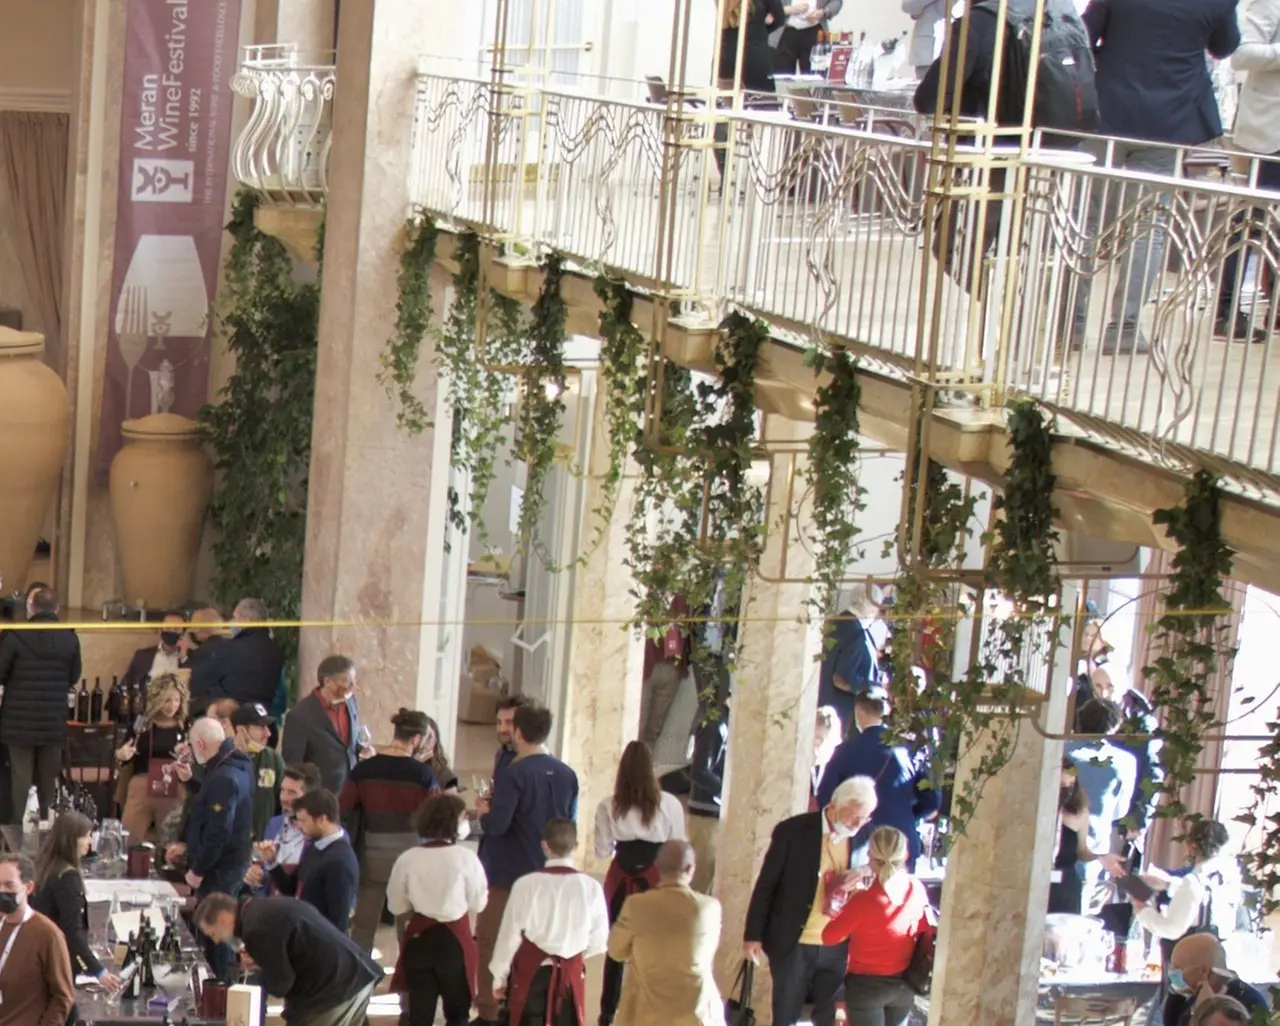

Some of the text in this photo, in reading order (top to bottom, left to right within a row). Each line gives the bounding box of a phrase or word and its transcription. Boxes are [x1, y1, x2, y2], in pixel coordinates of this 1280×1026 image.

[132, 74, 159, 151] Meran
[157, 0, 188, 151] WineFestival
[185, 88, 202, 153] since 1992
